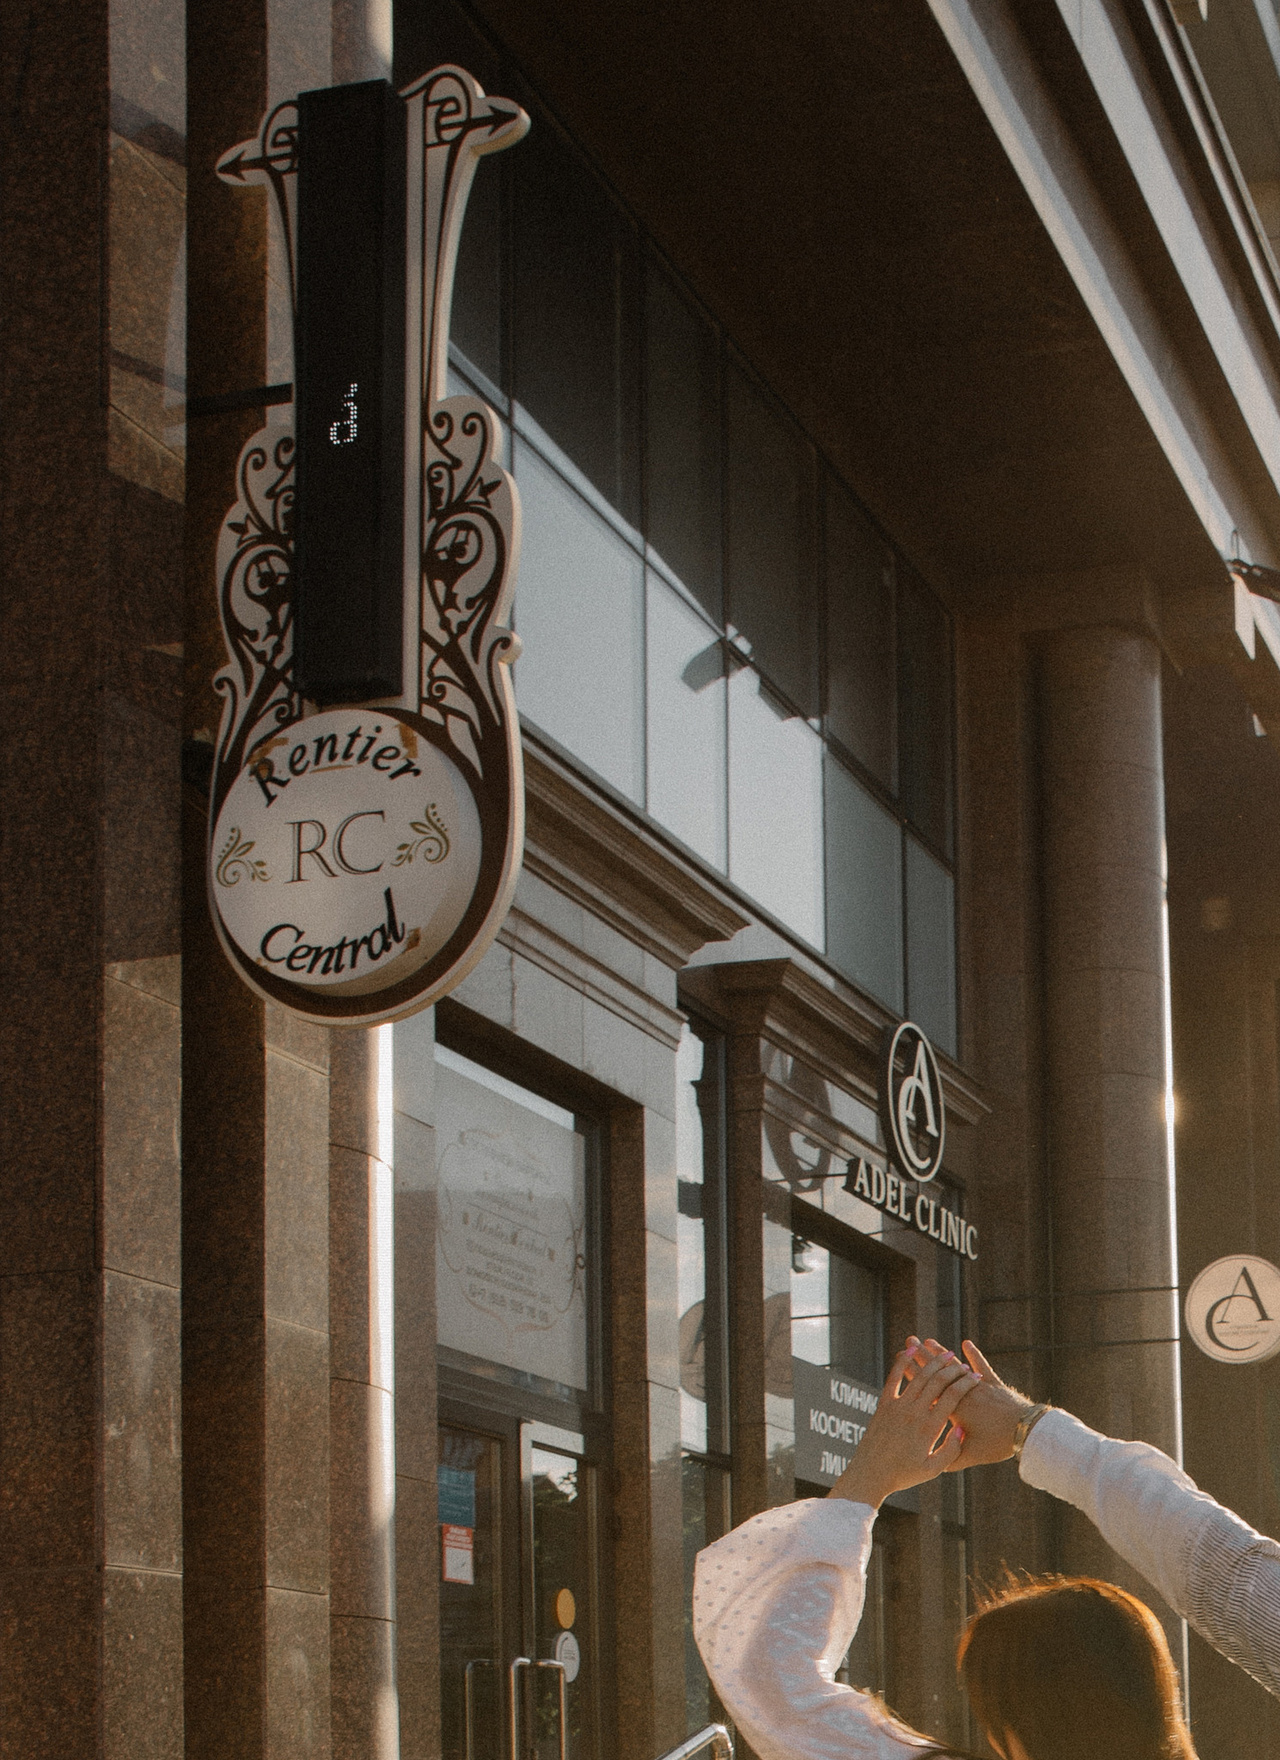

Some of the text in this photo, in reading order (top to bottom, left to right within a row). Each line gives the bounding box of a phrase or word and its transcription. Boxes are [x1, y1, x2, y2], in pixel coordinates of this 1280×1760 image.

[248, 725, 421, 807] Rentier
[284, 810, 386, 884] RC
[260, 886, 406, 976] Central
[854, 1158, 979, 1261] ADEL CLINIC
[830, 1379, 879, 1416] КЛИНИК
[819, 1450, 852, 1477] ЛИЦ
